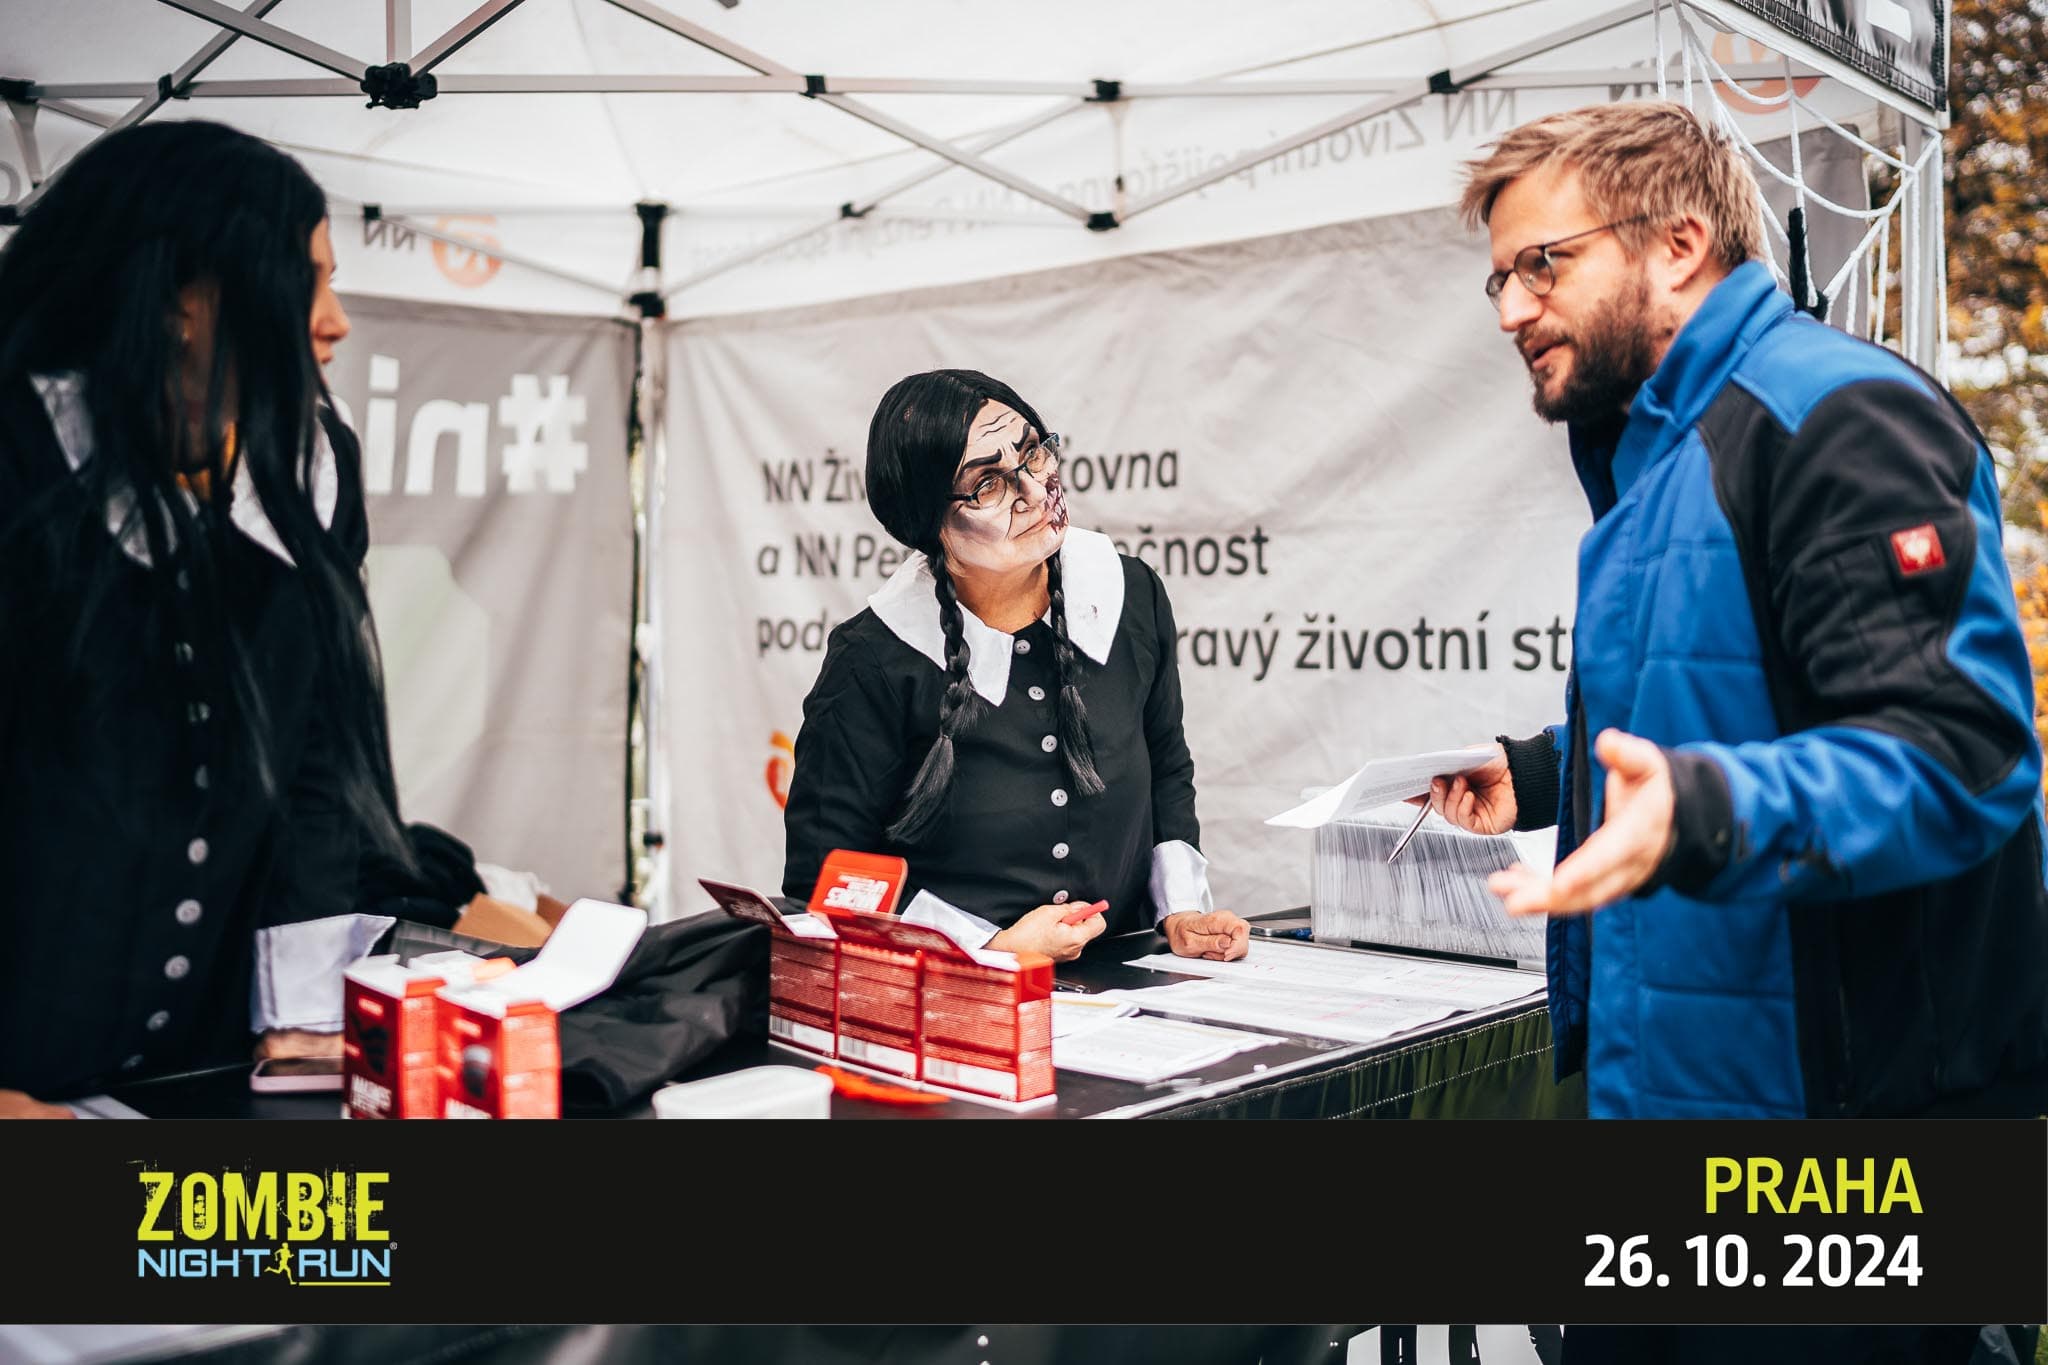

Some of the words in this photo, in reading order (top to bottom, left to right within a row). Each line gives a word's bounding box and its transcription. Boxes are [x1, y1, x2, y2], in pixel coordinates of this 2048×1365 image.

[762, 460, 813, 502] NN
[824, 449, 867, 502] Živ
[1059, 436, 1179, 493] ťovna
[757, 545, 779, 576] a
[796, 535, 839, 577] NN
[853, 533, 906, 578] Pe
[757, 608, 842, 657] pod
[1295, 610, 1489, 671] životní
[1512, 614, 1573, 672] st
